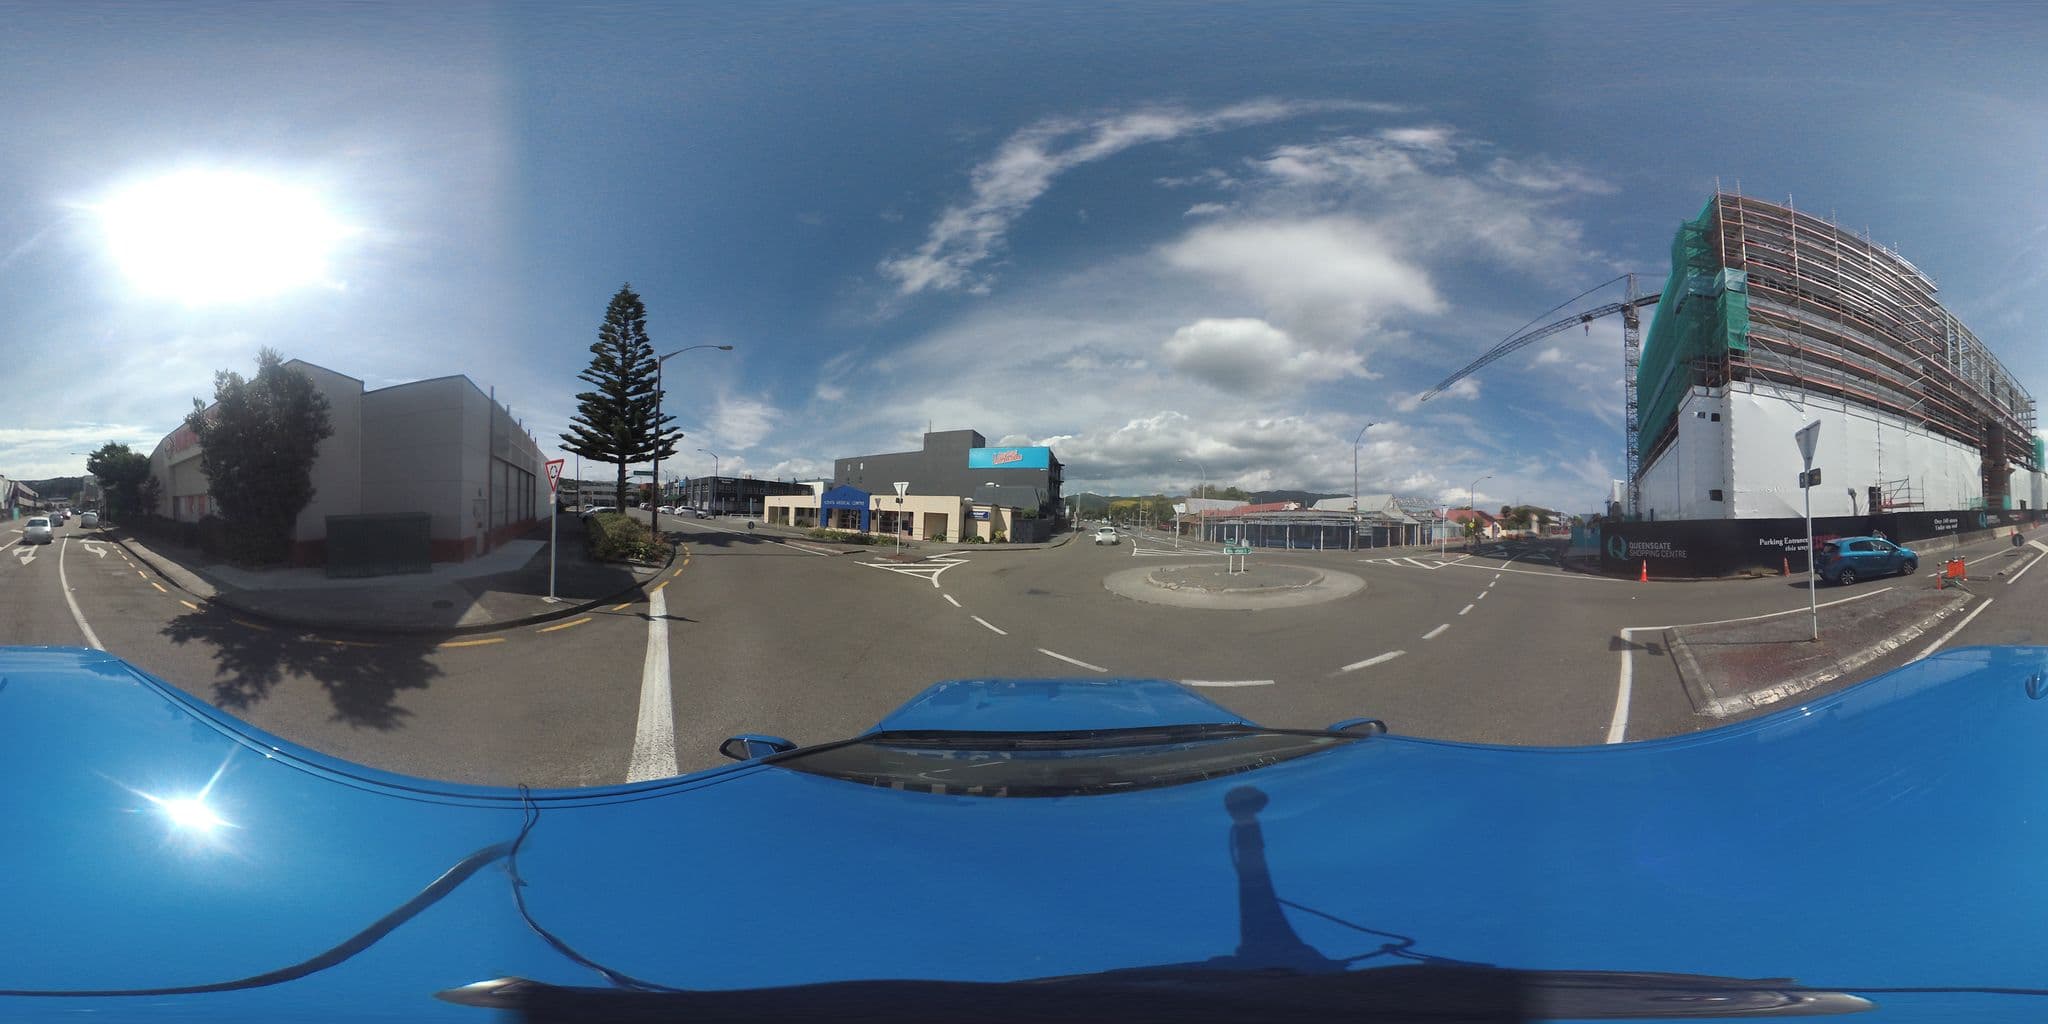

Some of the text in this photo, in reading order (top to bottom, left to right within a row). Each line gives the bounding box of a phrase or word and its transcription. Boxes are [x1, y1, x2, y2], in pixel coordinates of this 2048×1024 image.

[1629, 542, 1671, 550] QUEENSGATE
[1759, 538, 1783, 546] Parking
[1629, 549, 1687, 559] SHOPPING CENTRE
